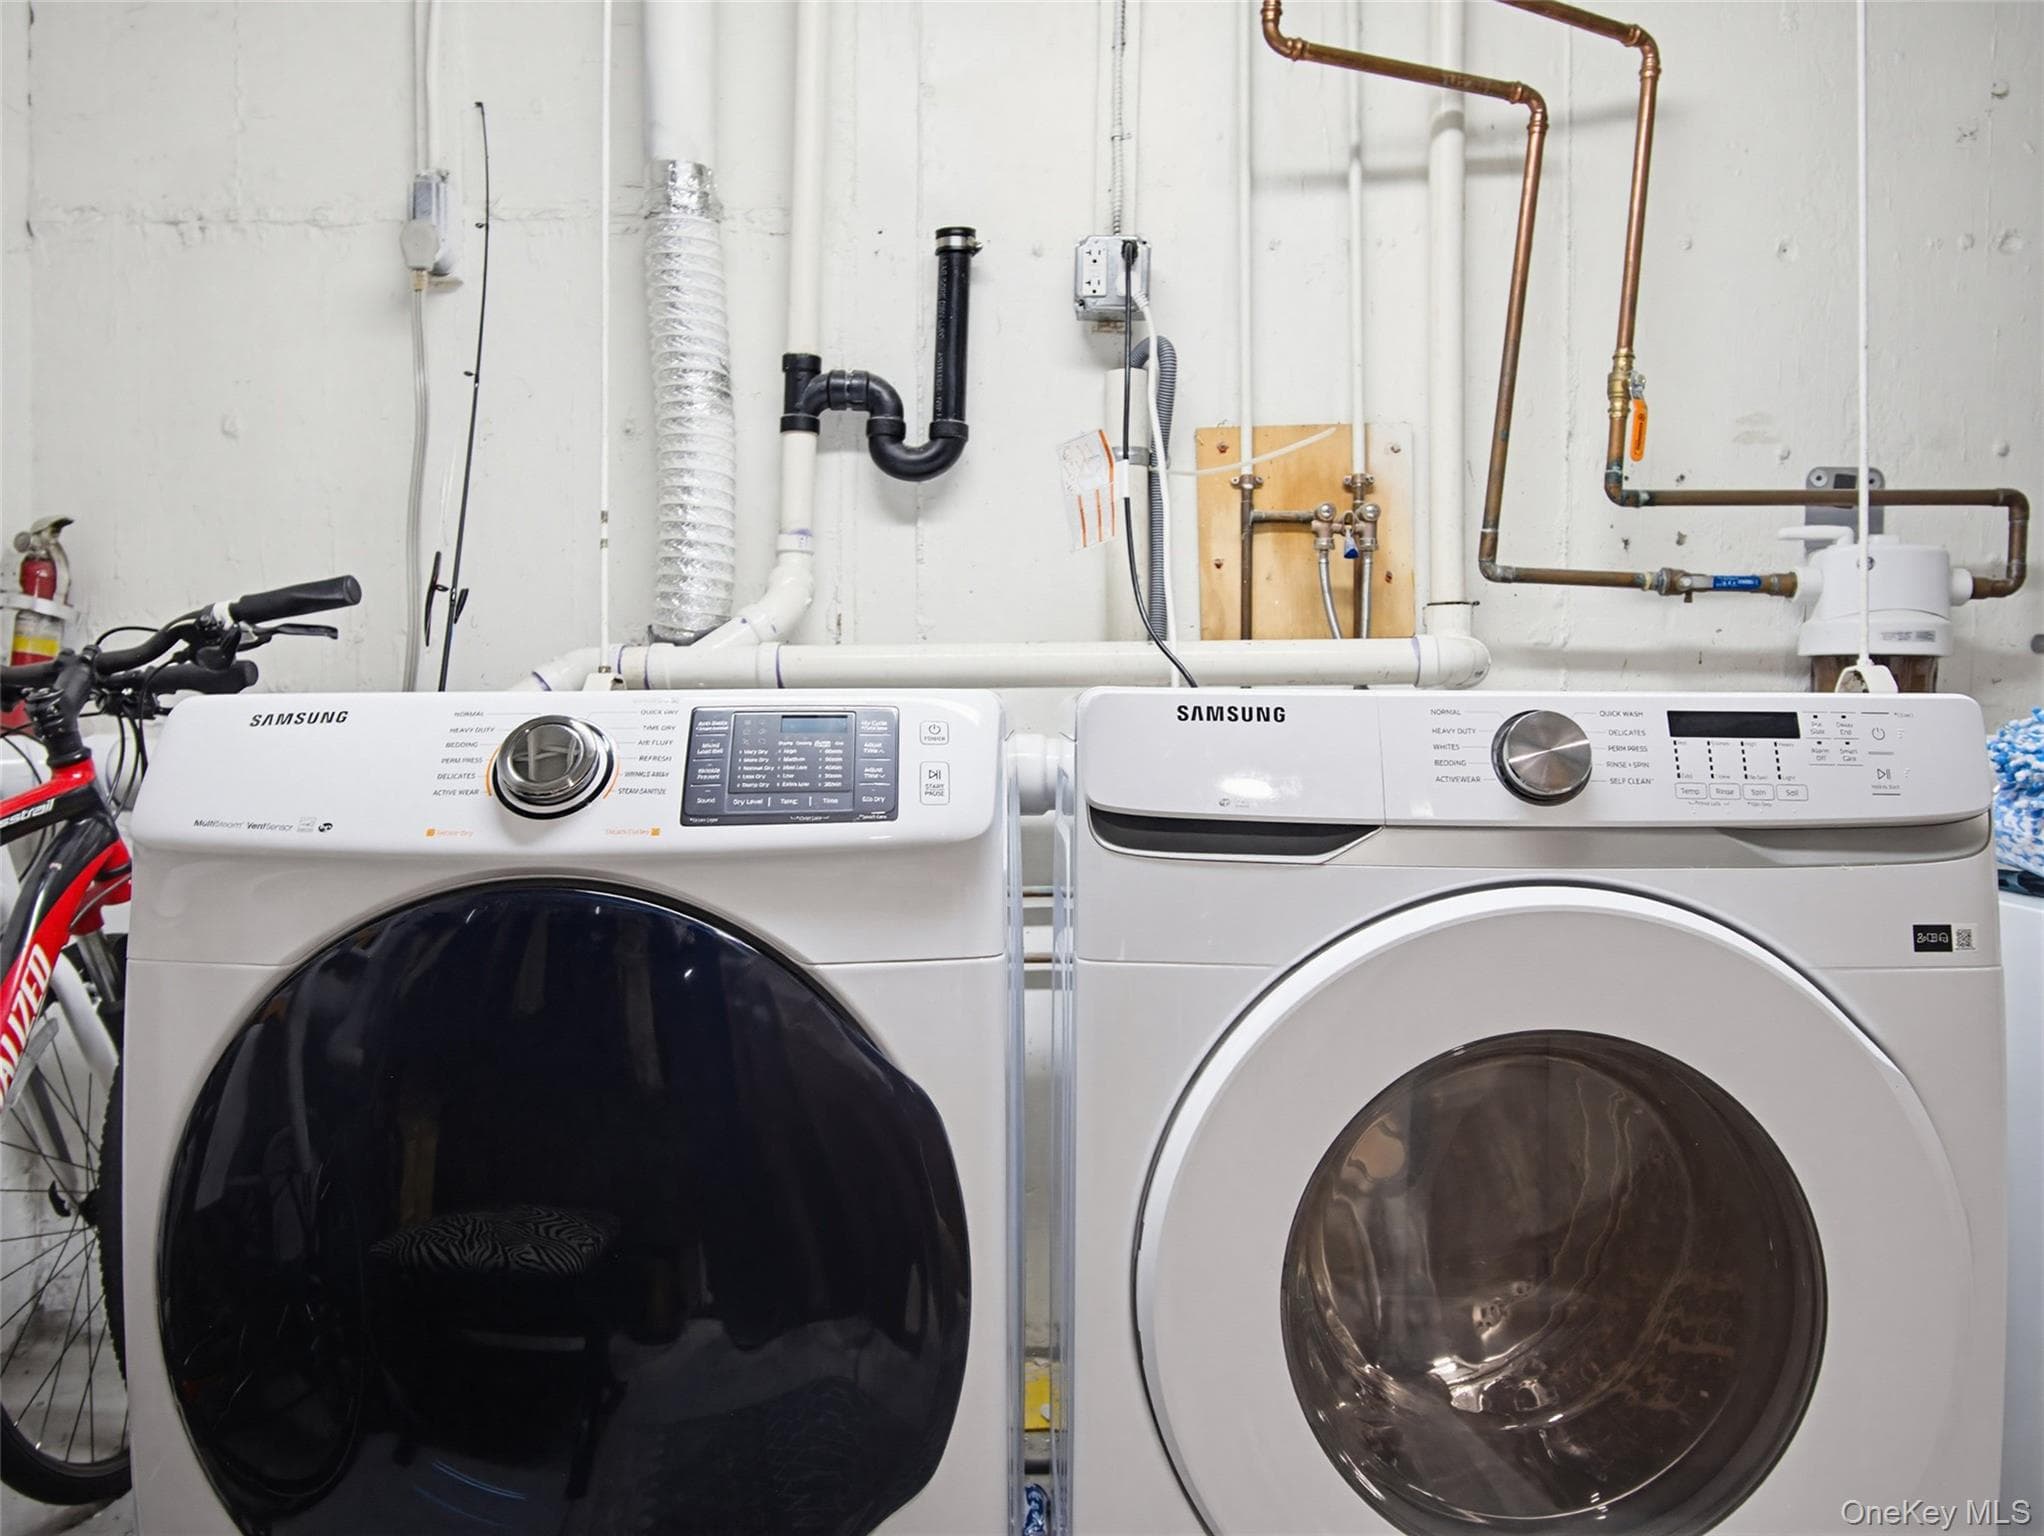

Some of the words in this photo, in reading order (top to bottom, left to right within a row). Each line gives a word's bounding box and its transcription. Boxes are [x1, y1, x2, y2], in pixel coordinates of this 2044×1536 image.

[250, 711, 349, 727] SAMSUNG
[1177, 705, 1286, 723] SAMSUNG
[1434, 759, 1467, 767] BEDDING
[1435, 775, 1481, 783] ACTIVEWEAR
